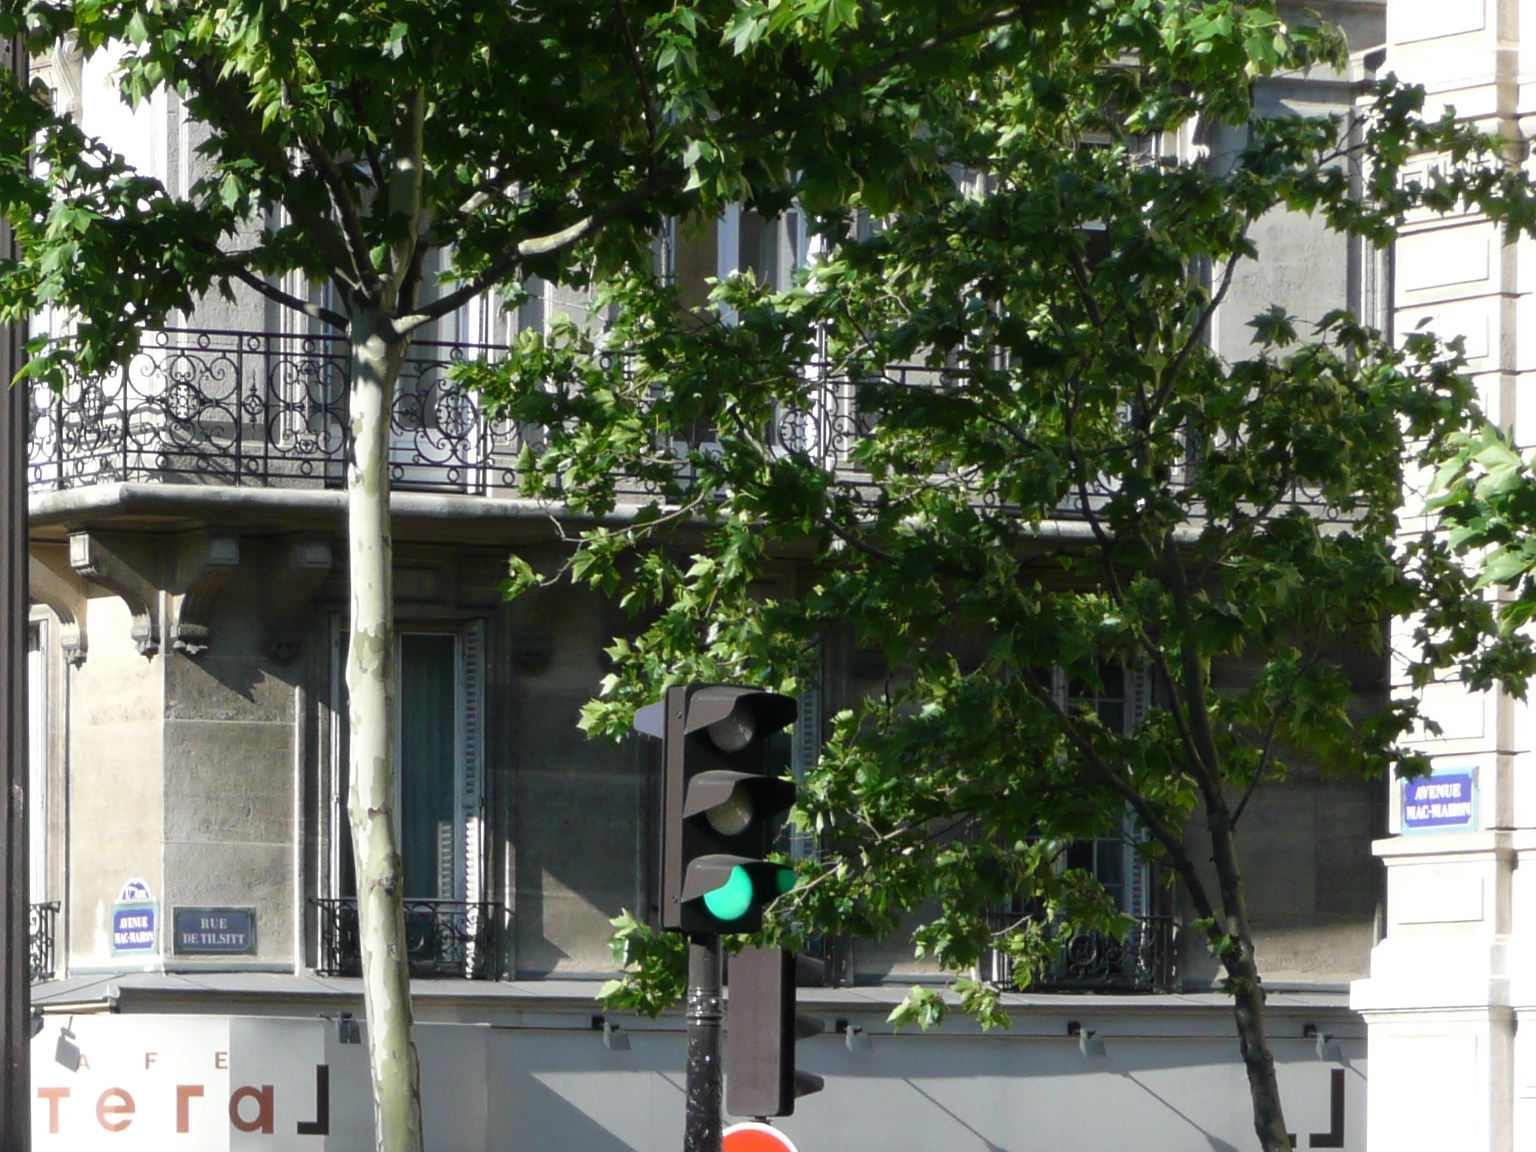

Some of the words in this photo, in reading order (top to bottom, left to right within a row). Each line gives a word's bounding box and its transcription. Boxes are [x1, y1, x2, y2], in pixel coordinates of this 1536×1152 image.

[1415, 783, 1462, 800] AVENUE
[1406, 802, 1471, 820] MAC-MAHON
[119, 916, 148, 929] AVENUE
[200, 918, 227, 930] RUE
[182, 933, 199, 944] DE
[200, 933, 245, 945] TILSITT
